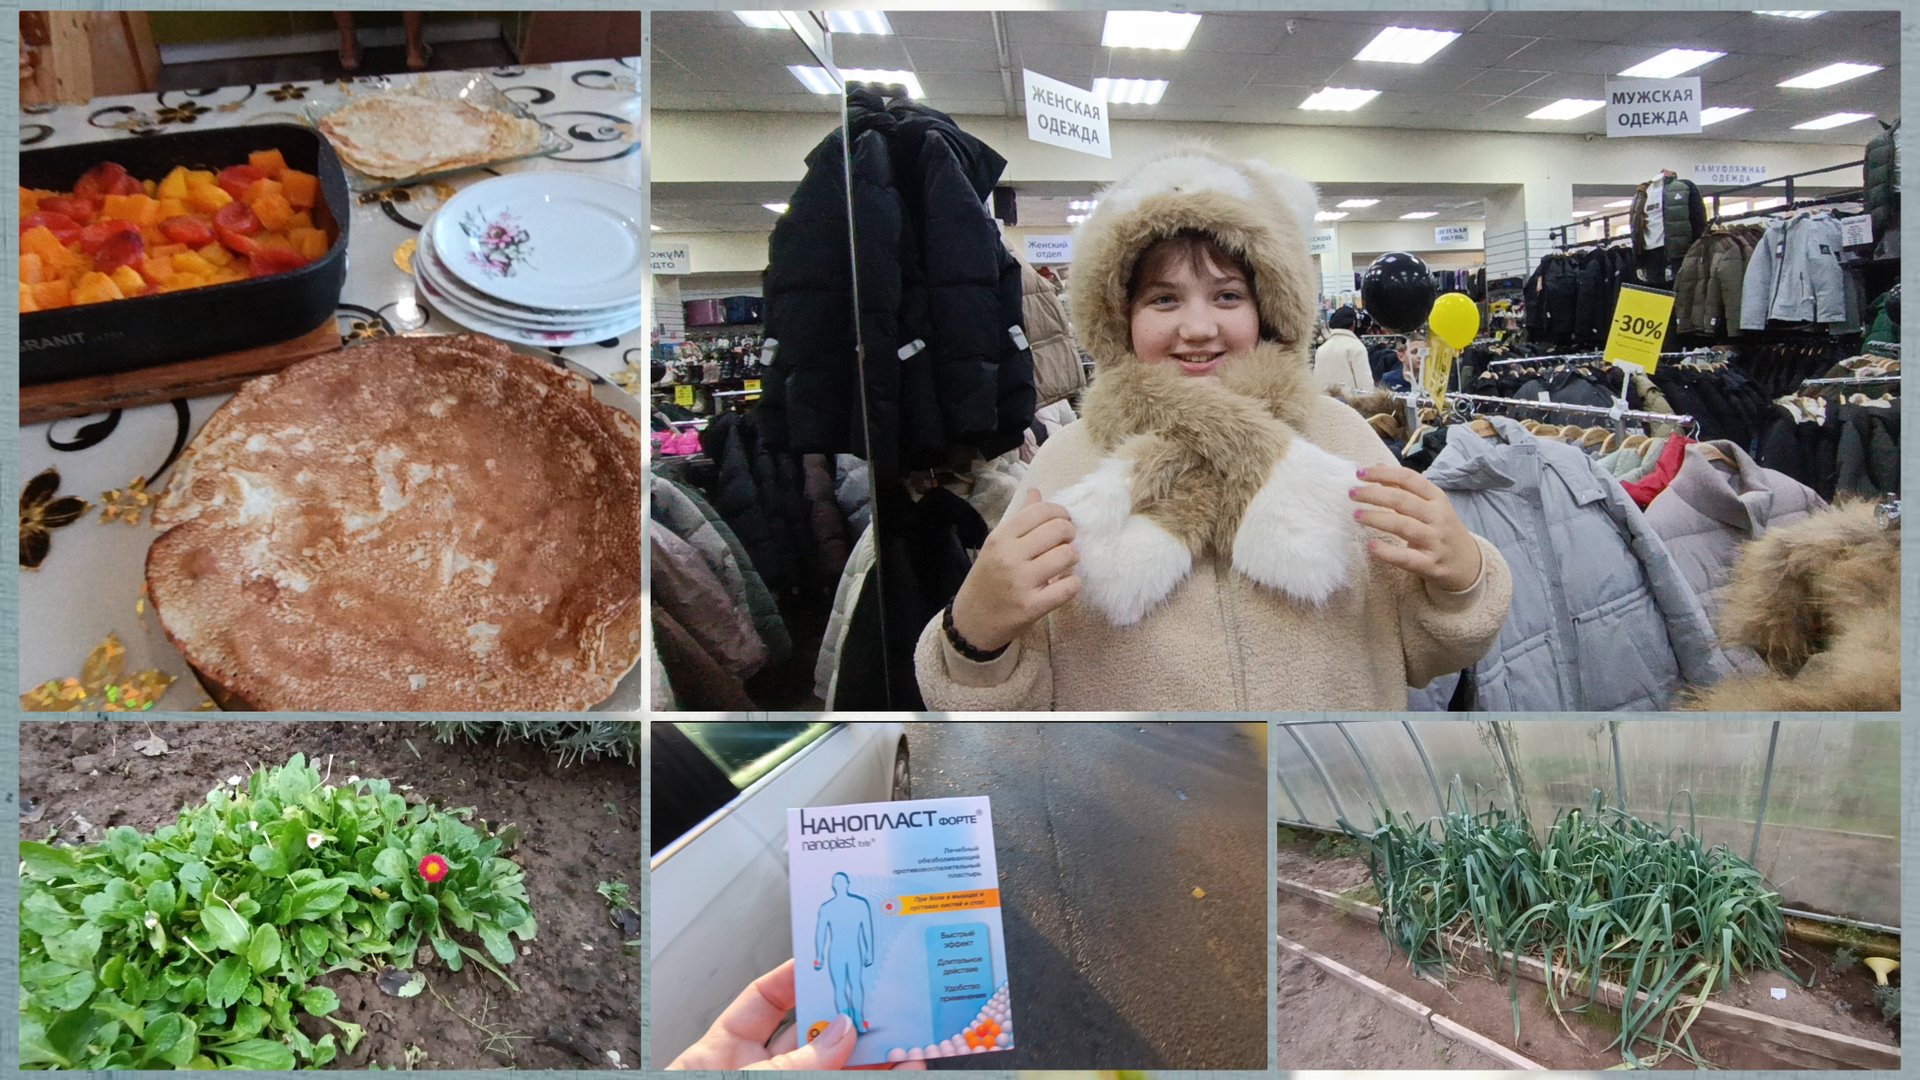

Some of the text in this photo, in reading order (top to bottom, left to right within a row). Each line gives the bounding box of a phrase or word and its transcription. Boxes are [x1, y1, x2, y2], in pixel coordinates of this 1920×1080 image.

[1612, 88, 1693, 105] МУЖСКАЯ
[1032, 85, 1100, 121] ЖЕНСКАЯ
[1618, 110, 1689, 128] ОДЕЖДА
[1038, 114, 1100, 144] ОДЕЖДА
[1694, 164, 1767, 174] КАМУФЛЯЖНАЯ
[1712, 173, 1751, 183] ОДЕЖДА
[1028, 241, 1068, 249] Женский
[1035, 251, 1062, 259] отдел
[1614, 315, 1663, 340] -30%
[801, 809, 937, 835] НАНОПЛАСТ
[802, 836, 856, 851] nanoplast
[944, 845, 979, 854] Лечебный
[941, 930, 976, 939] Быстрый
[944, 940, 974, 949] эффект
